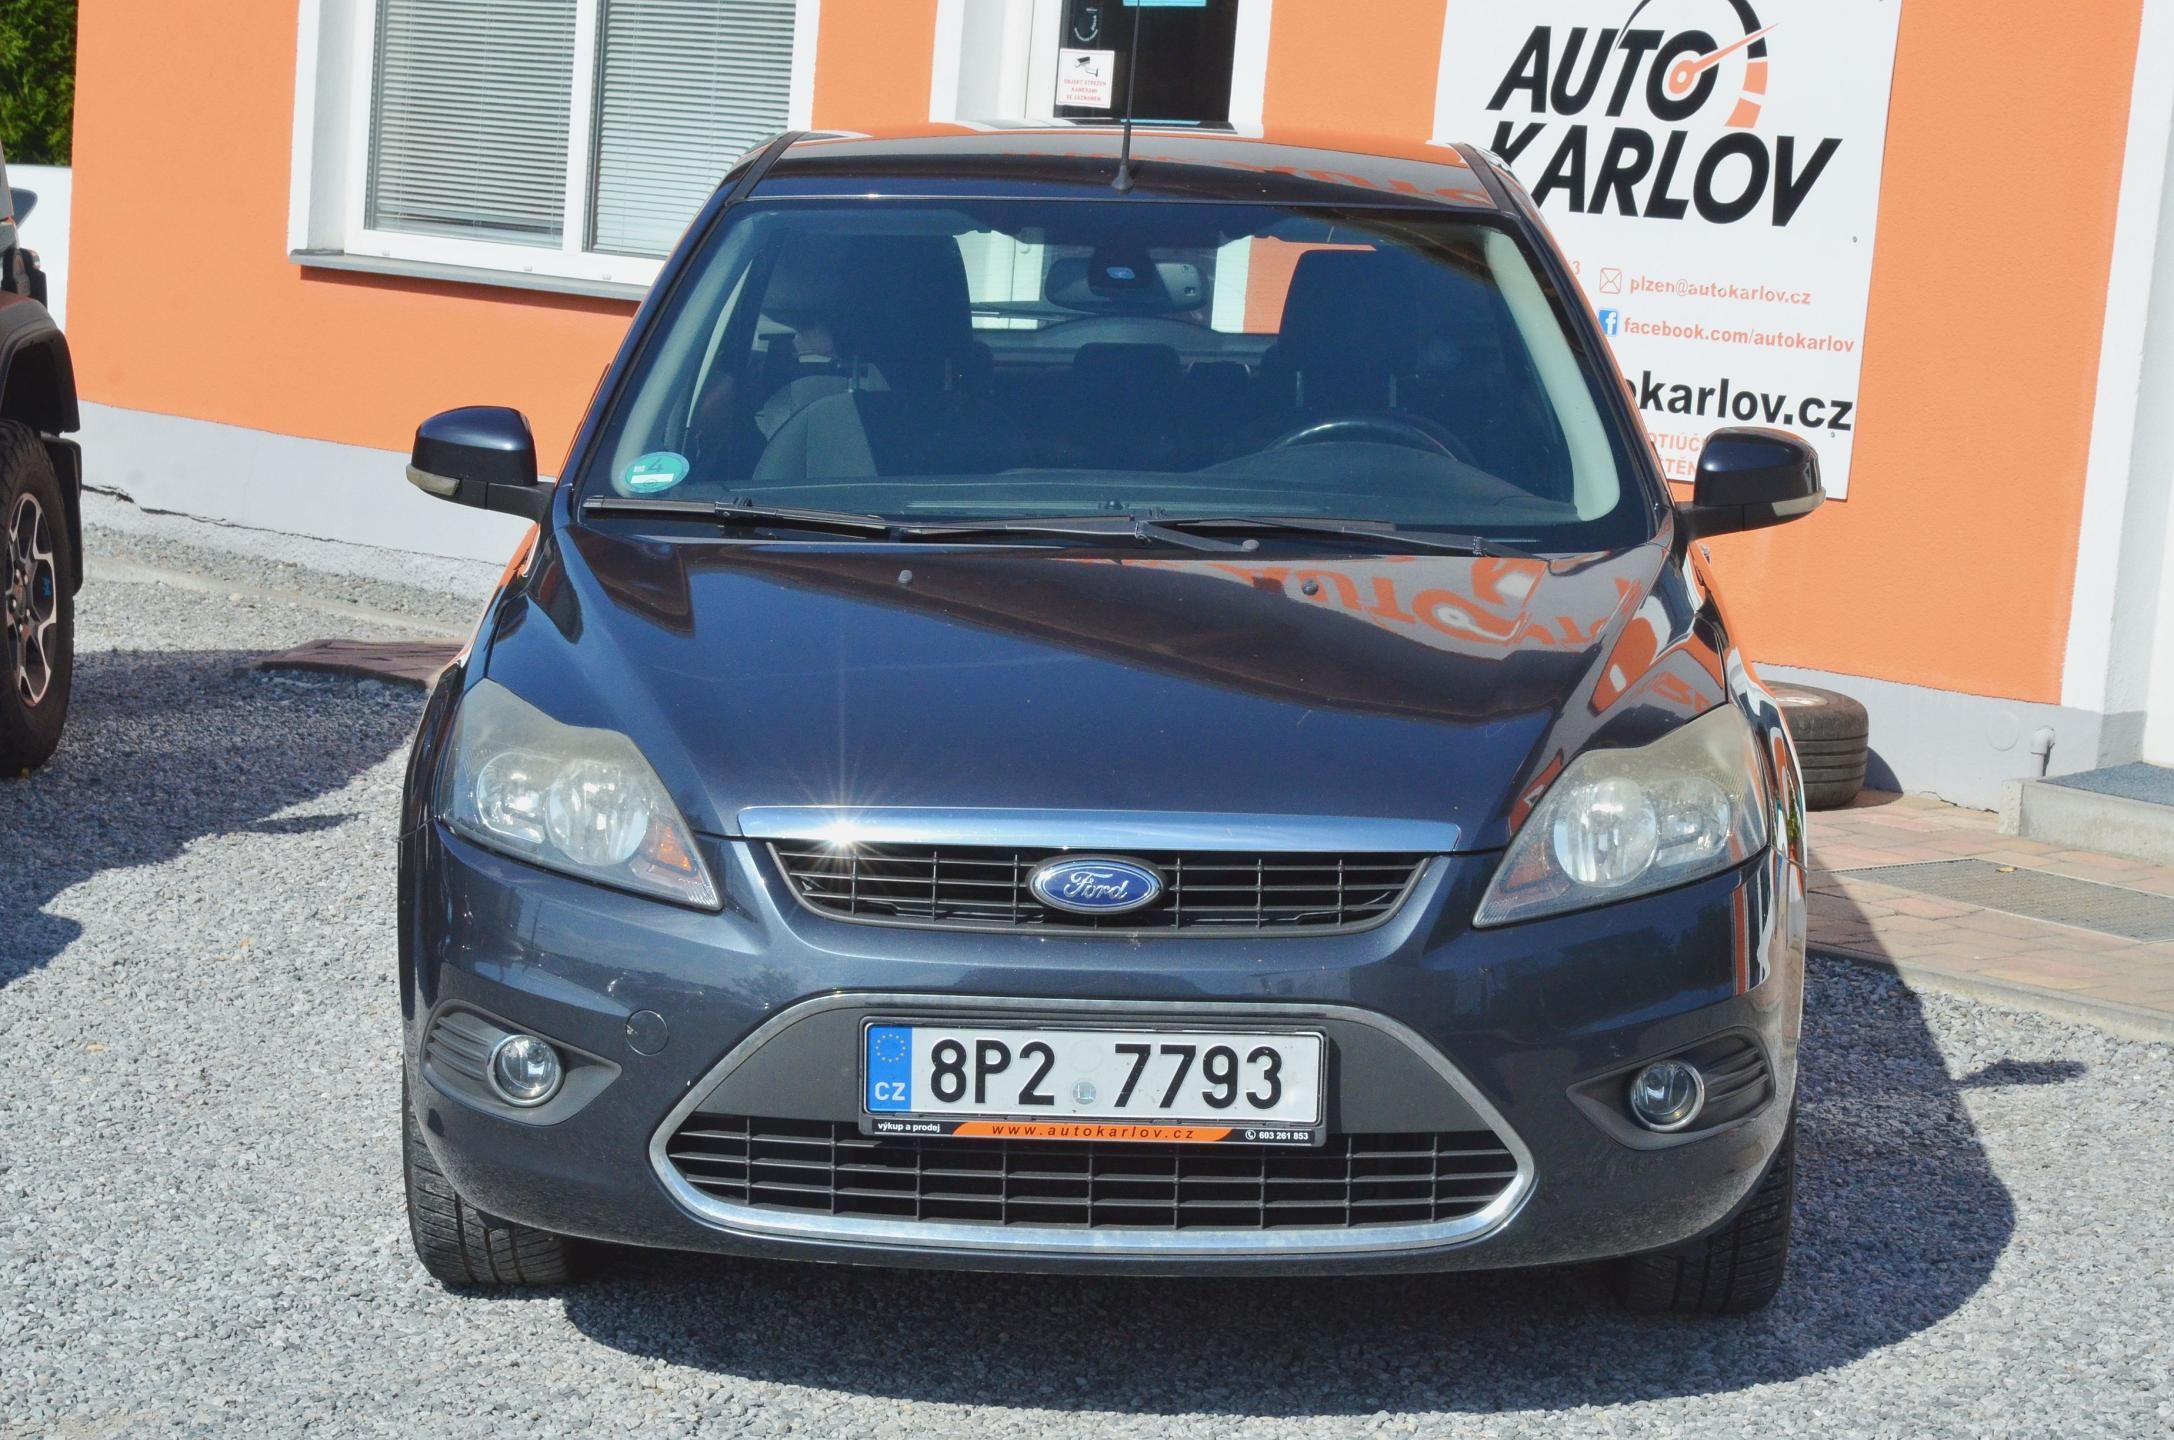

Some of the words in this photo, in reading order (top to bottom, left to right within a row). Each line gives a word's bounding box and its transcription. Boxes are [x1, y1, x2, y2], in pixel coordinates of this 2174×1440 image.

[1485, 25, 1720, 121] AUTO
[1490, 121, 1843, 227] KARLOV
[1629, 276, 1811, 305] plzen@autokarlov.cz
[1624, 317, 1854, 352] facebook.com/autokarlov
[1063, 871, 1130, 900] Ford
[930, 1039, 1056, 1106] 8P2
[1113, 1043, 1283, 1110] 7793
[874, 1081, 906, 1101] CZ
[878, 1121, 904, 1132] výkup
[912, 1123, 940, 1133] prodej
[991, 1124, 1195, 1140] www.autokarlov.cz
[1258, 1131, 1275, 1140] 603
[1276, 1131, 1291, 1140] 261
[1293, 1132, 1309, 1141] 853
